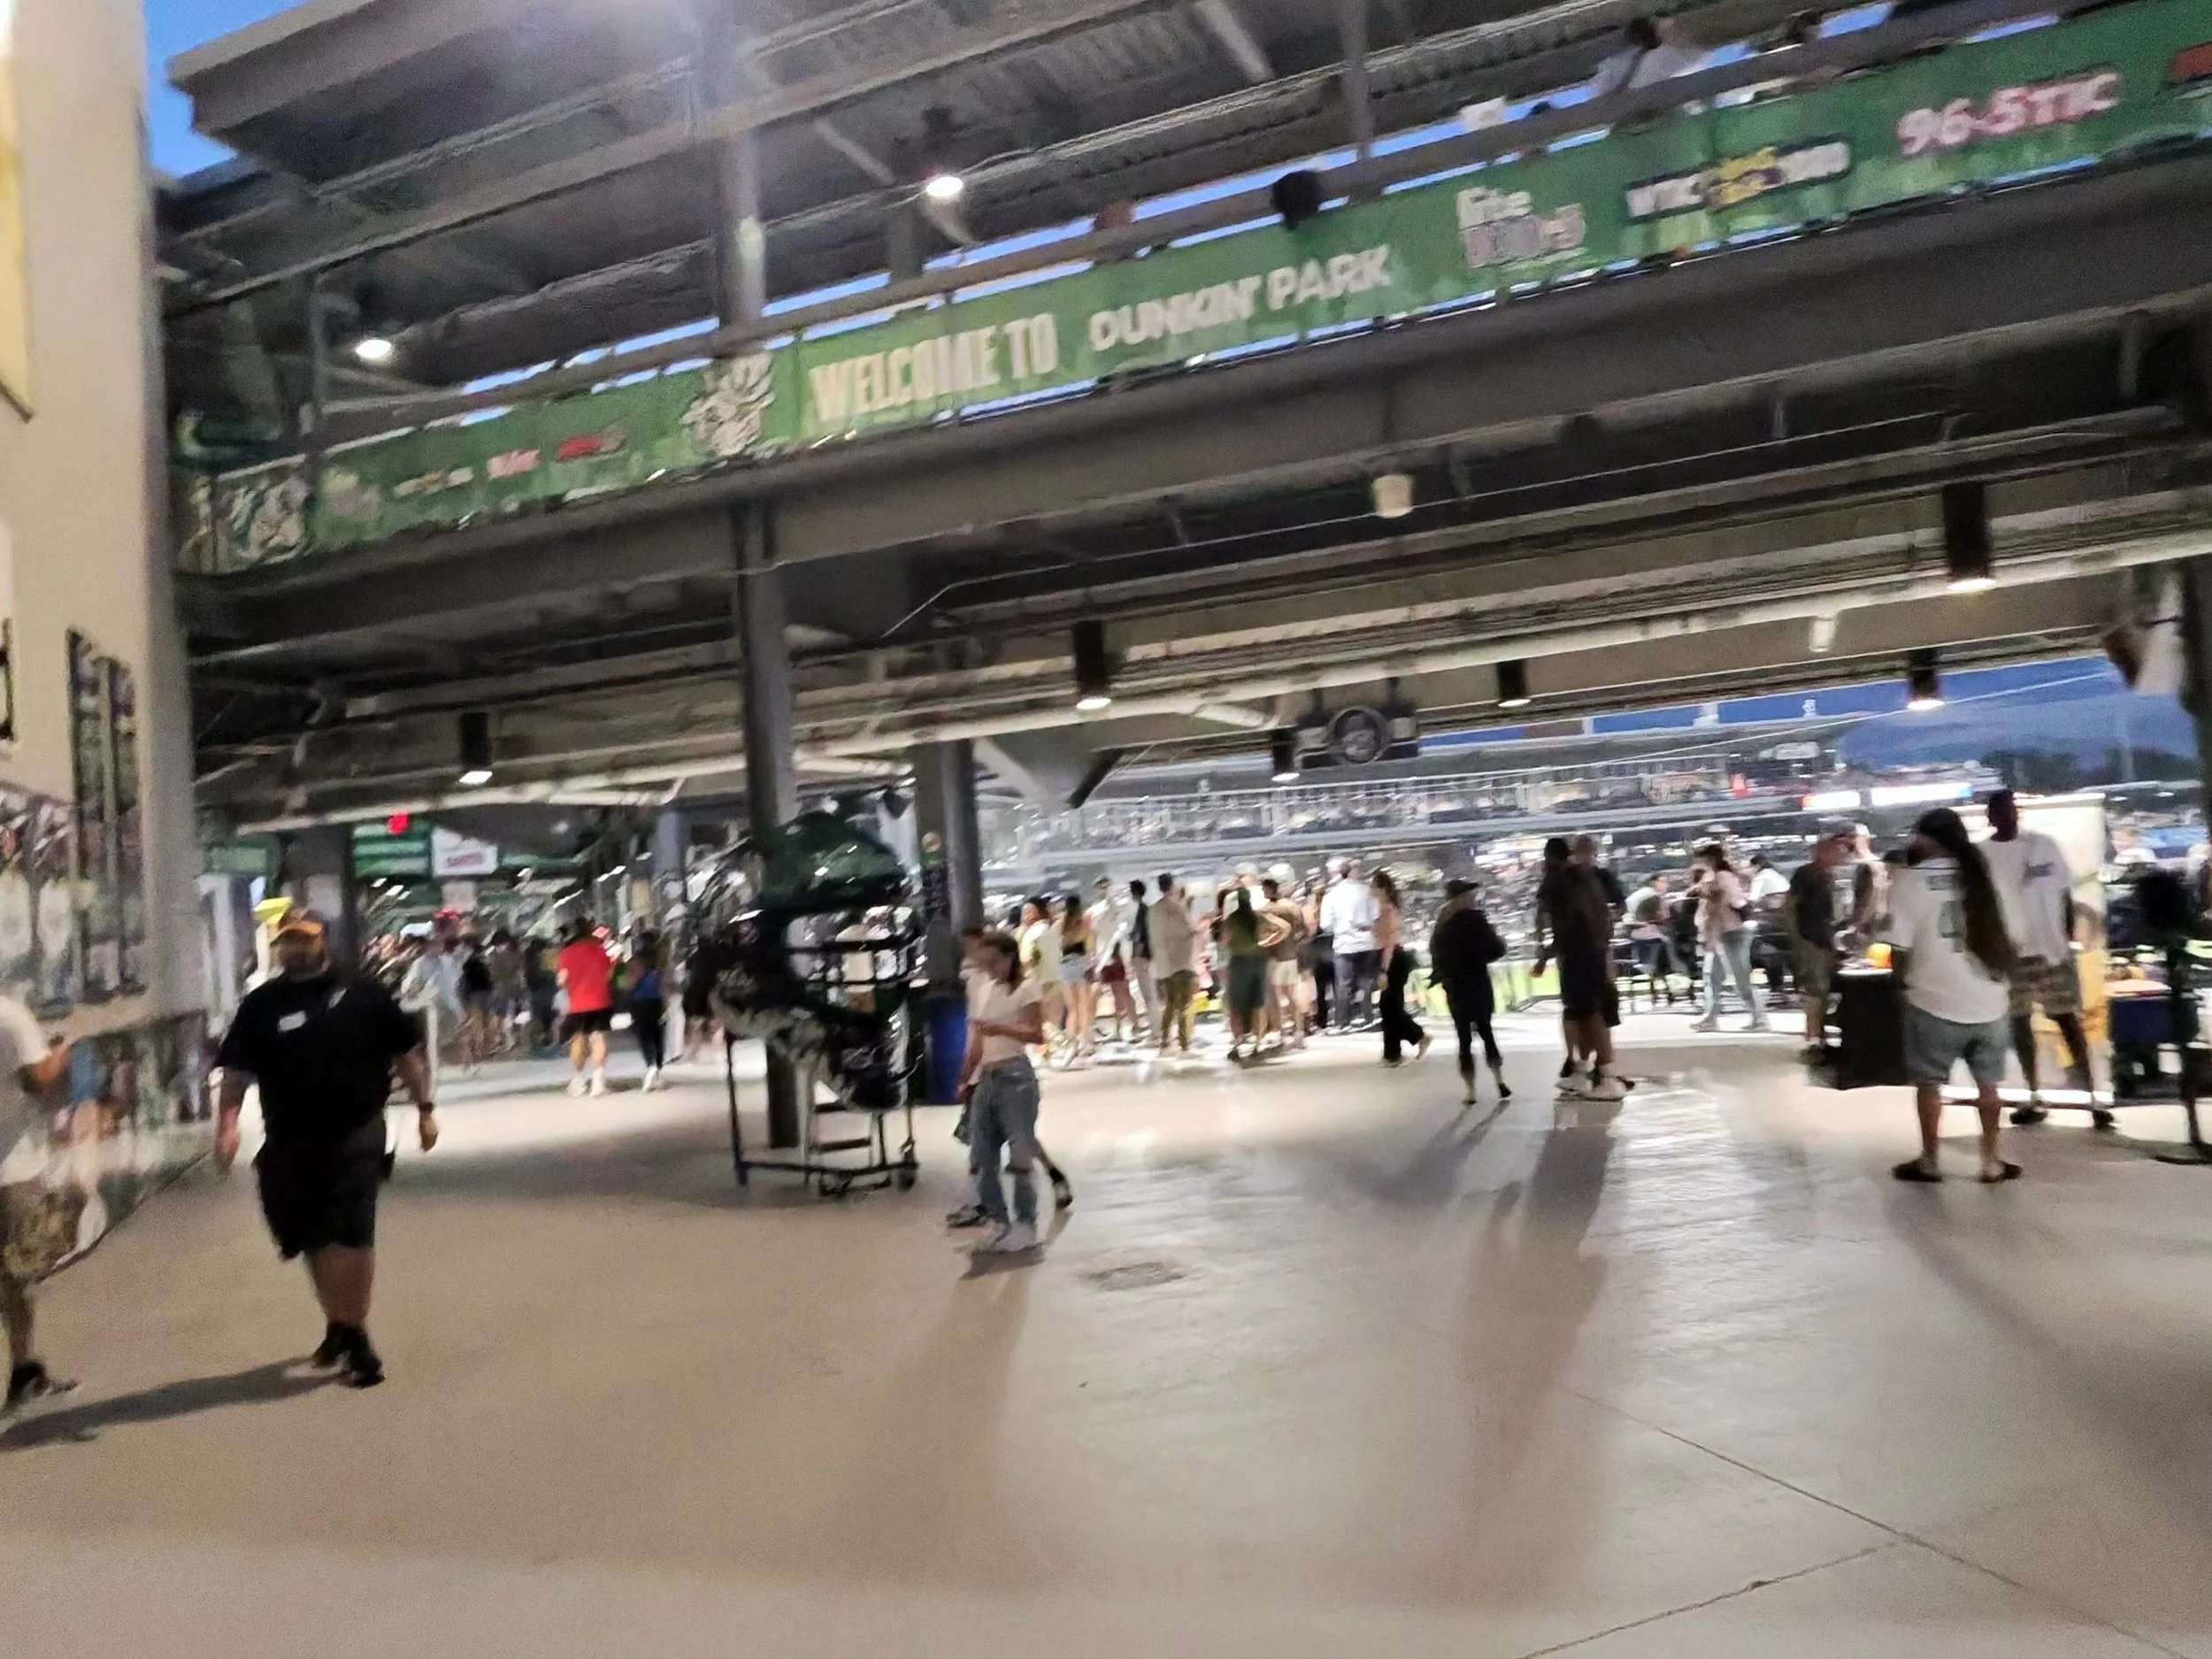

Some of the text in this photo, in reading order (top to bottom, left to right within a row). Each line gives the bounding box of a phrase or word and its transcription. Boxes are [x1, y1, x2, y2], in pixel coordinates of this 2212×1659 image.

[809, 325, 1001, 420] WELCOME
[1002, 312, 1058, 380] TO
[1266, 243, 1394, 310] PARK
